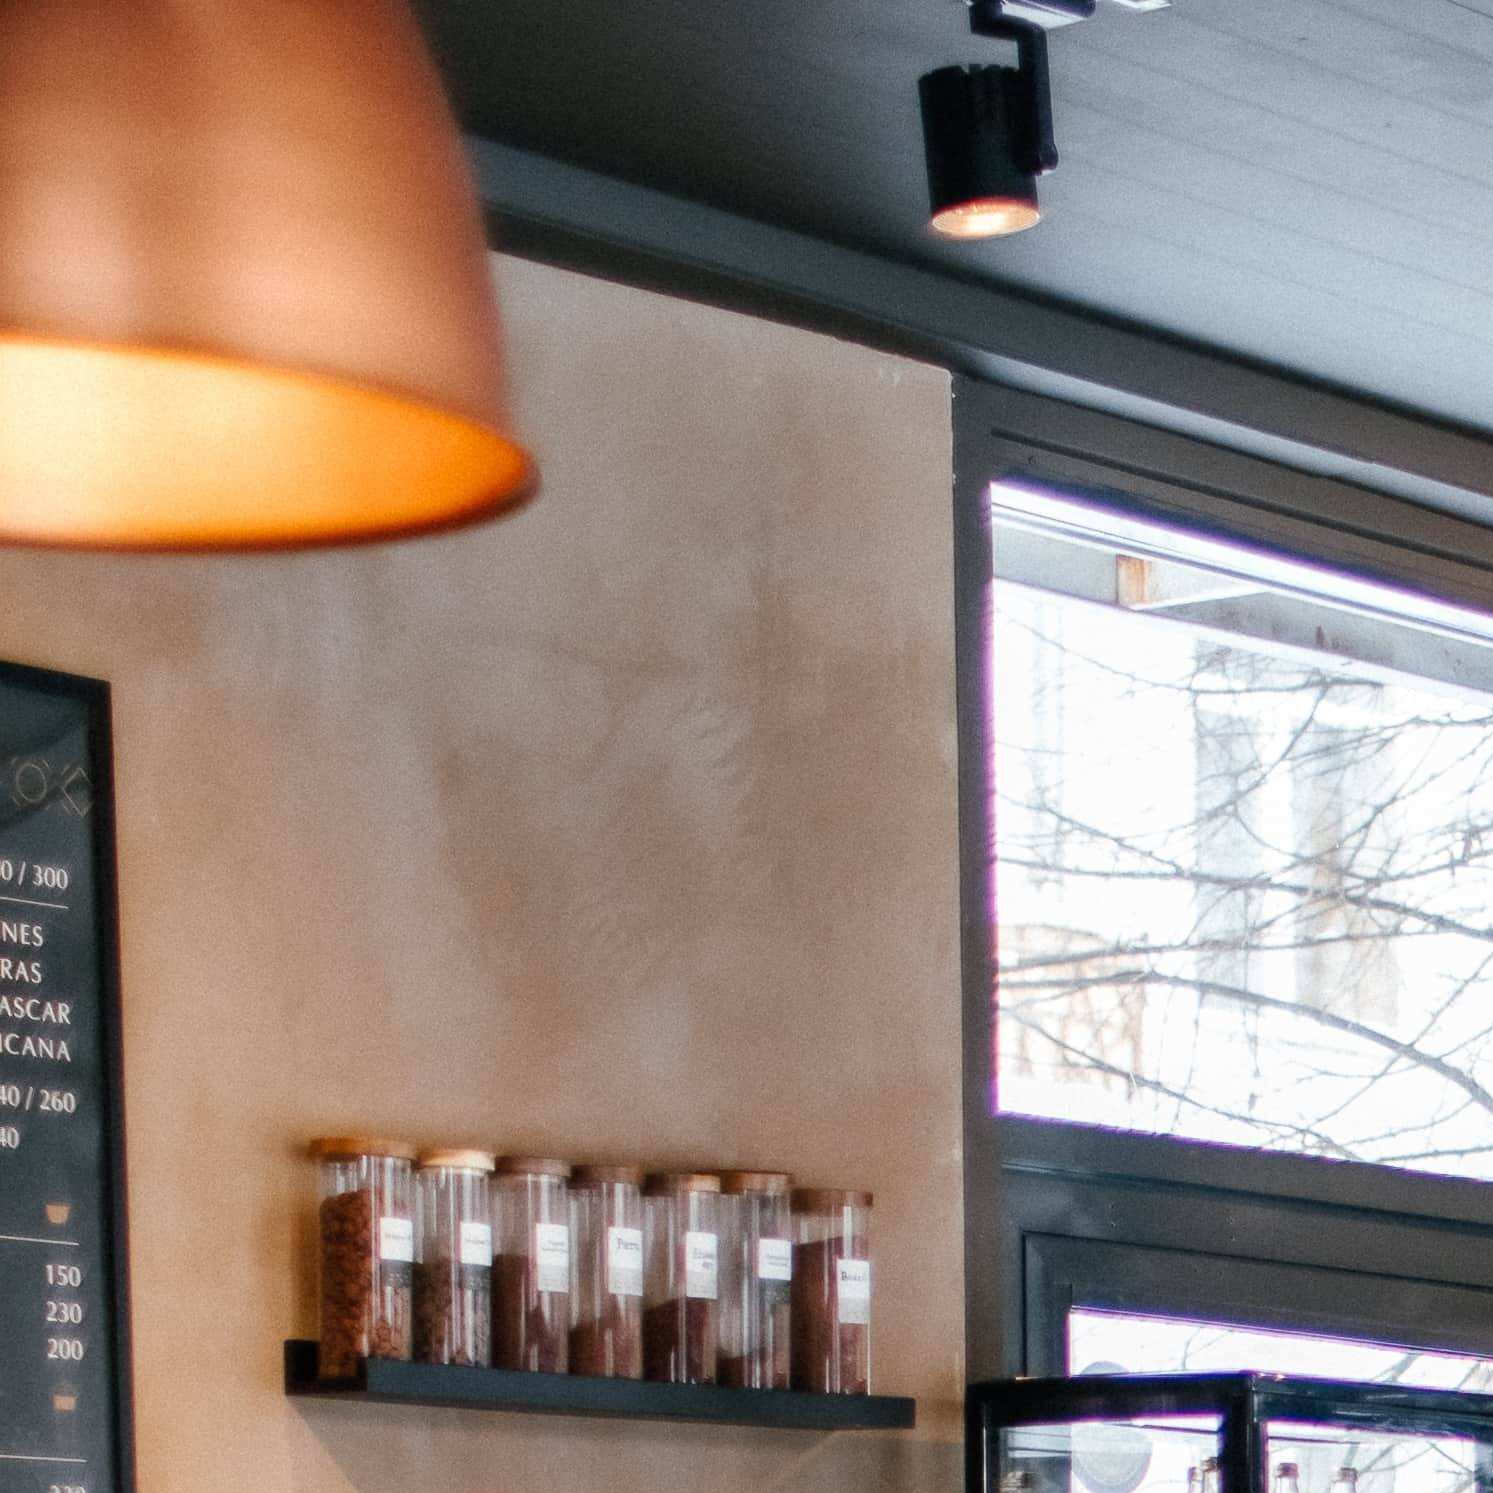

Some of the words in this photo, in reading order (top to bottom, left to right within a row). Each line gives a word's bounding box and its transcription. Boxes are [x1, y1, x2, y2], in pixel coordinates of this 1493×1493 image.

[32, 864, 69, 890] 300
[1, 920, 44, 947] NES
[0, 958, 42, 984] RAS
[0, 994, 71, 1025] ASCAR
[40, 1089, 76, 1113] 260
[45, 1264, 82, 1287] 150
[46, 1300, 83, 1324] 230
[47, 1338, 84, 1361] 200
